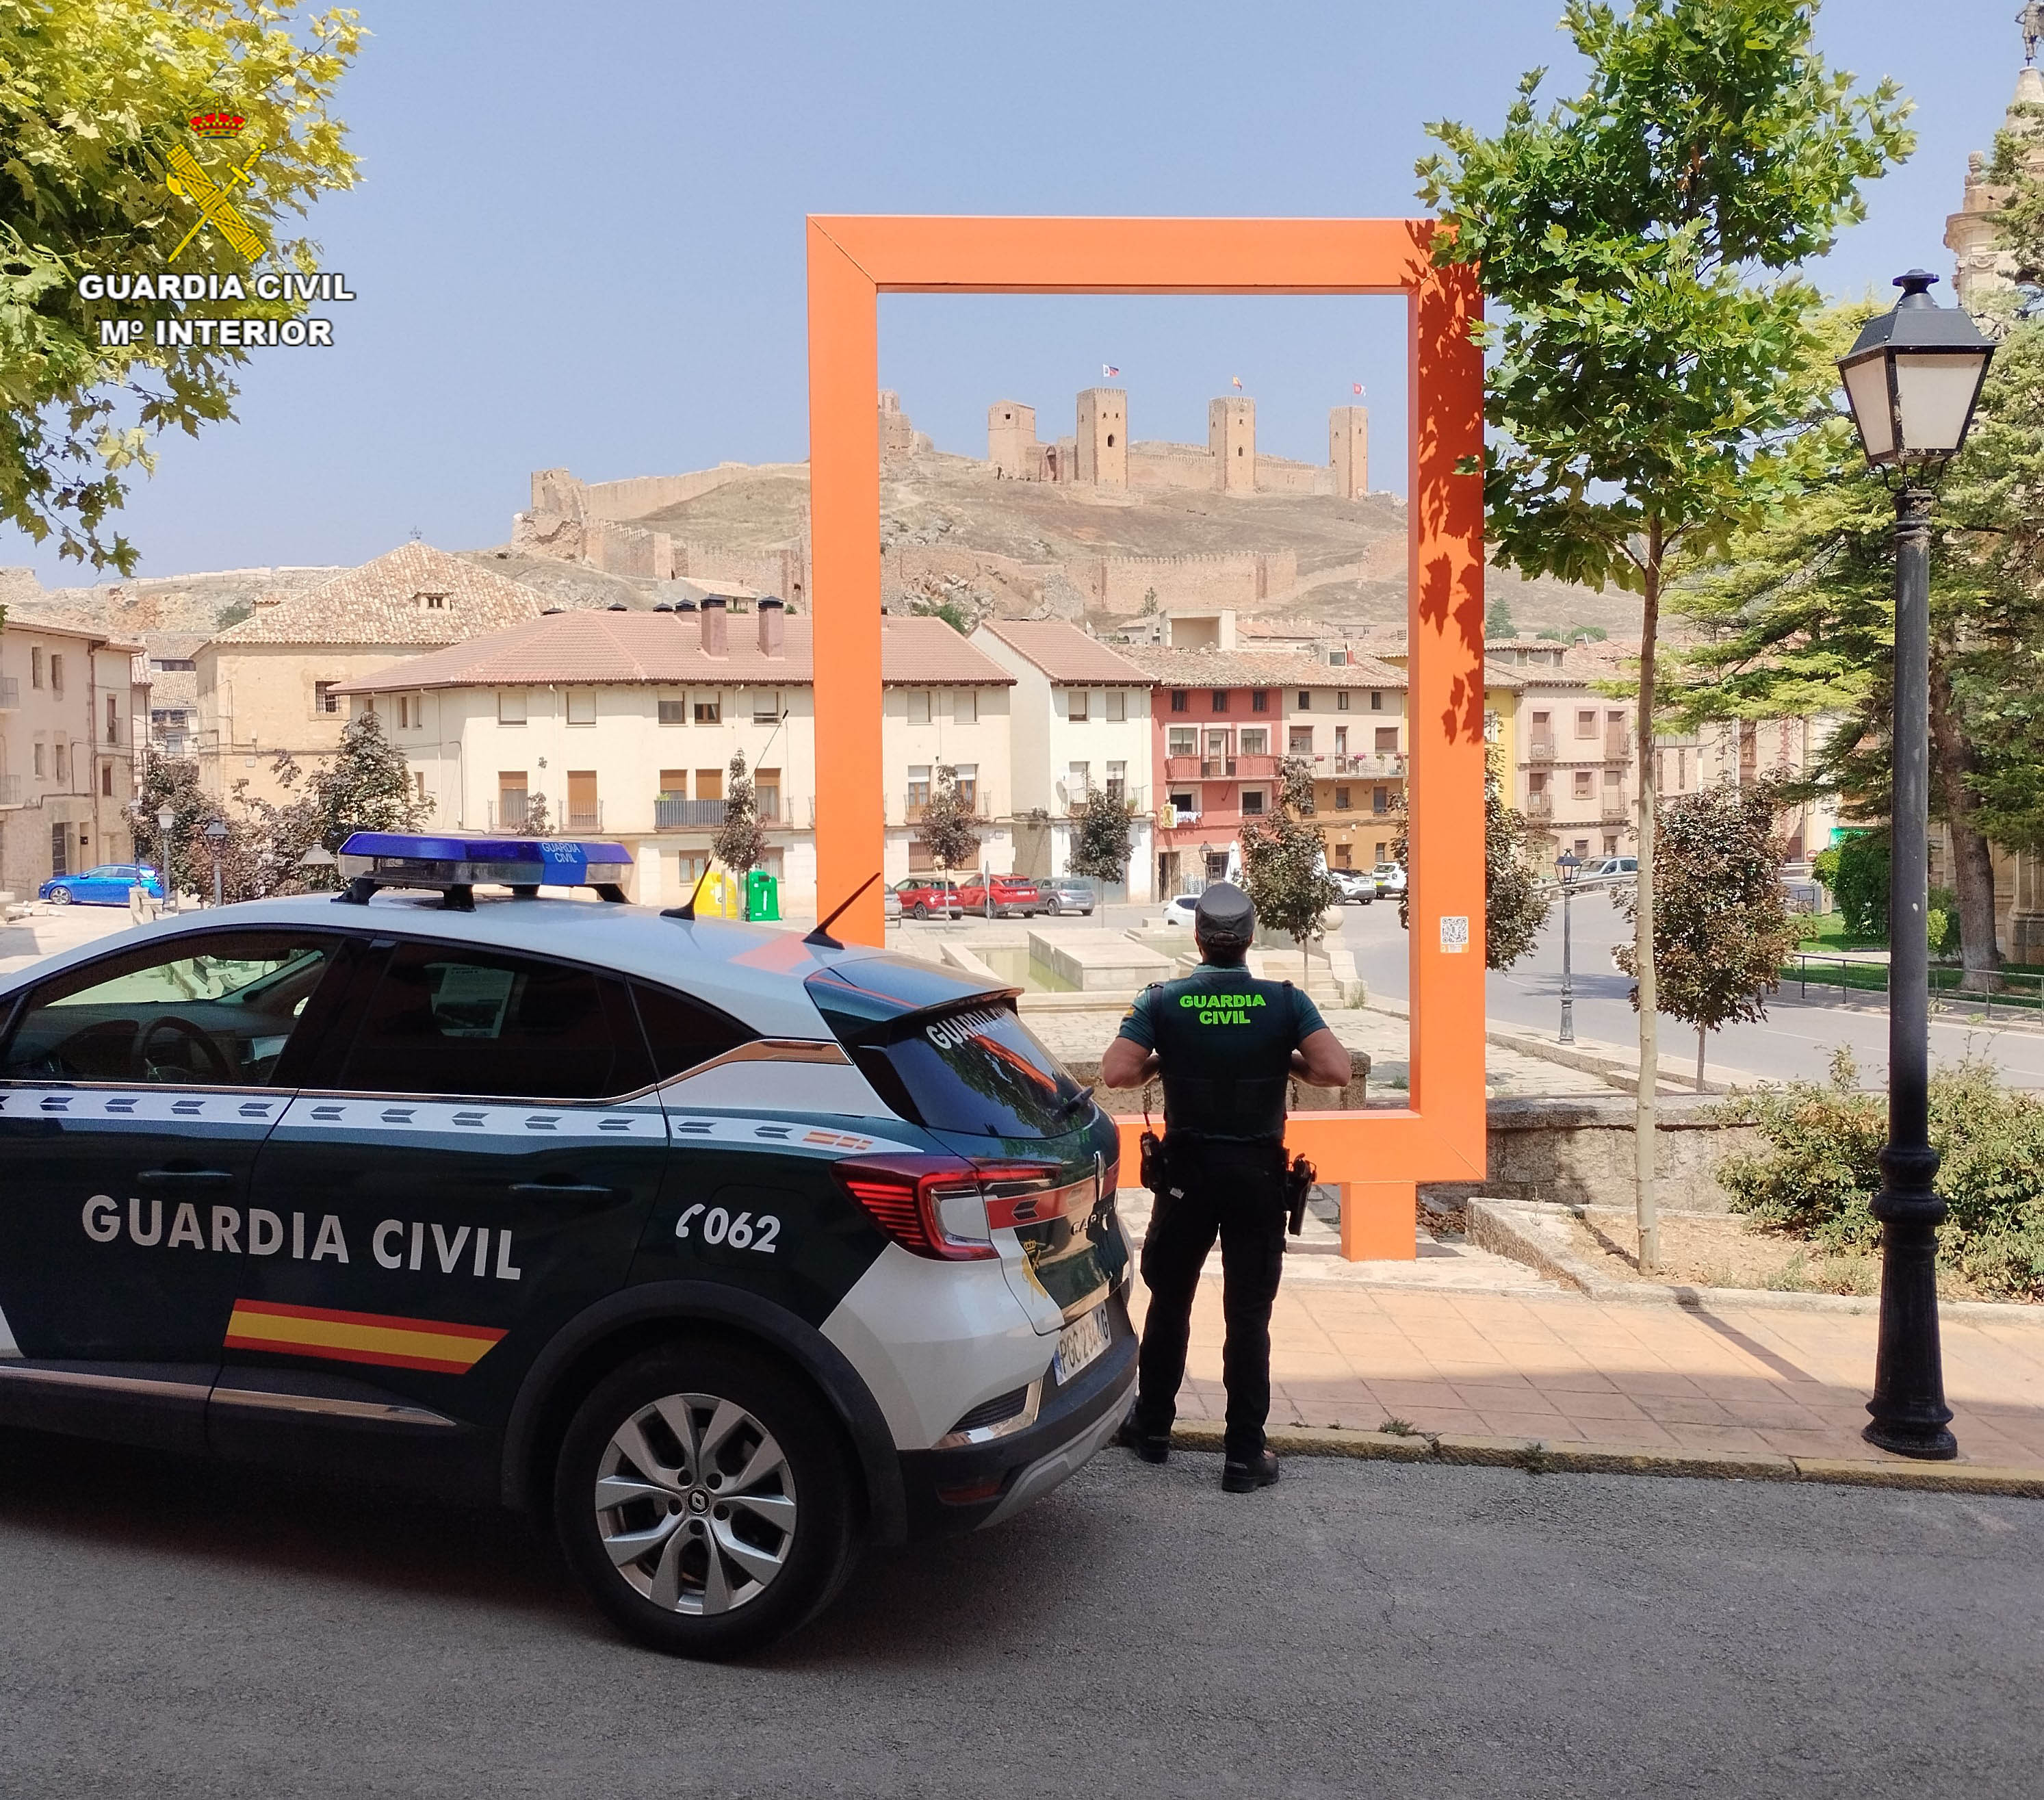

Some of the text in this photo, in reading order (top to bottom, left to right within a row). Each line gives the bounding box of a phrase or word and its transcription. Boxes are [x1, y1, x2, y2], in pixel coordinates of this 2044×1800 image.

[542, 843, 581, 853] GUARDIA
[555, 853, 578, 863] CIVIL
[1180, 994, 1266, 1007] GUARDIA
[1200, 1010, 1251, 1025] CIVIL
[82, 1194, 521, 1280] GUARDIA CIVIL
[704, 1207, 780, 1253] 062
[1059, 1330, 1081, 1374] PGC
